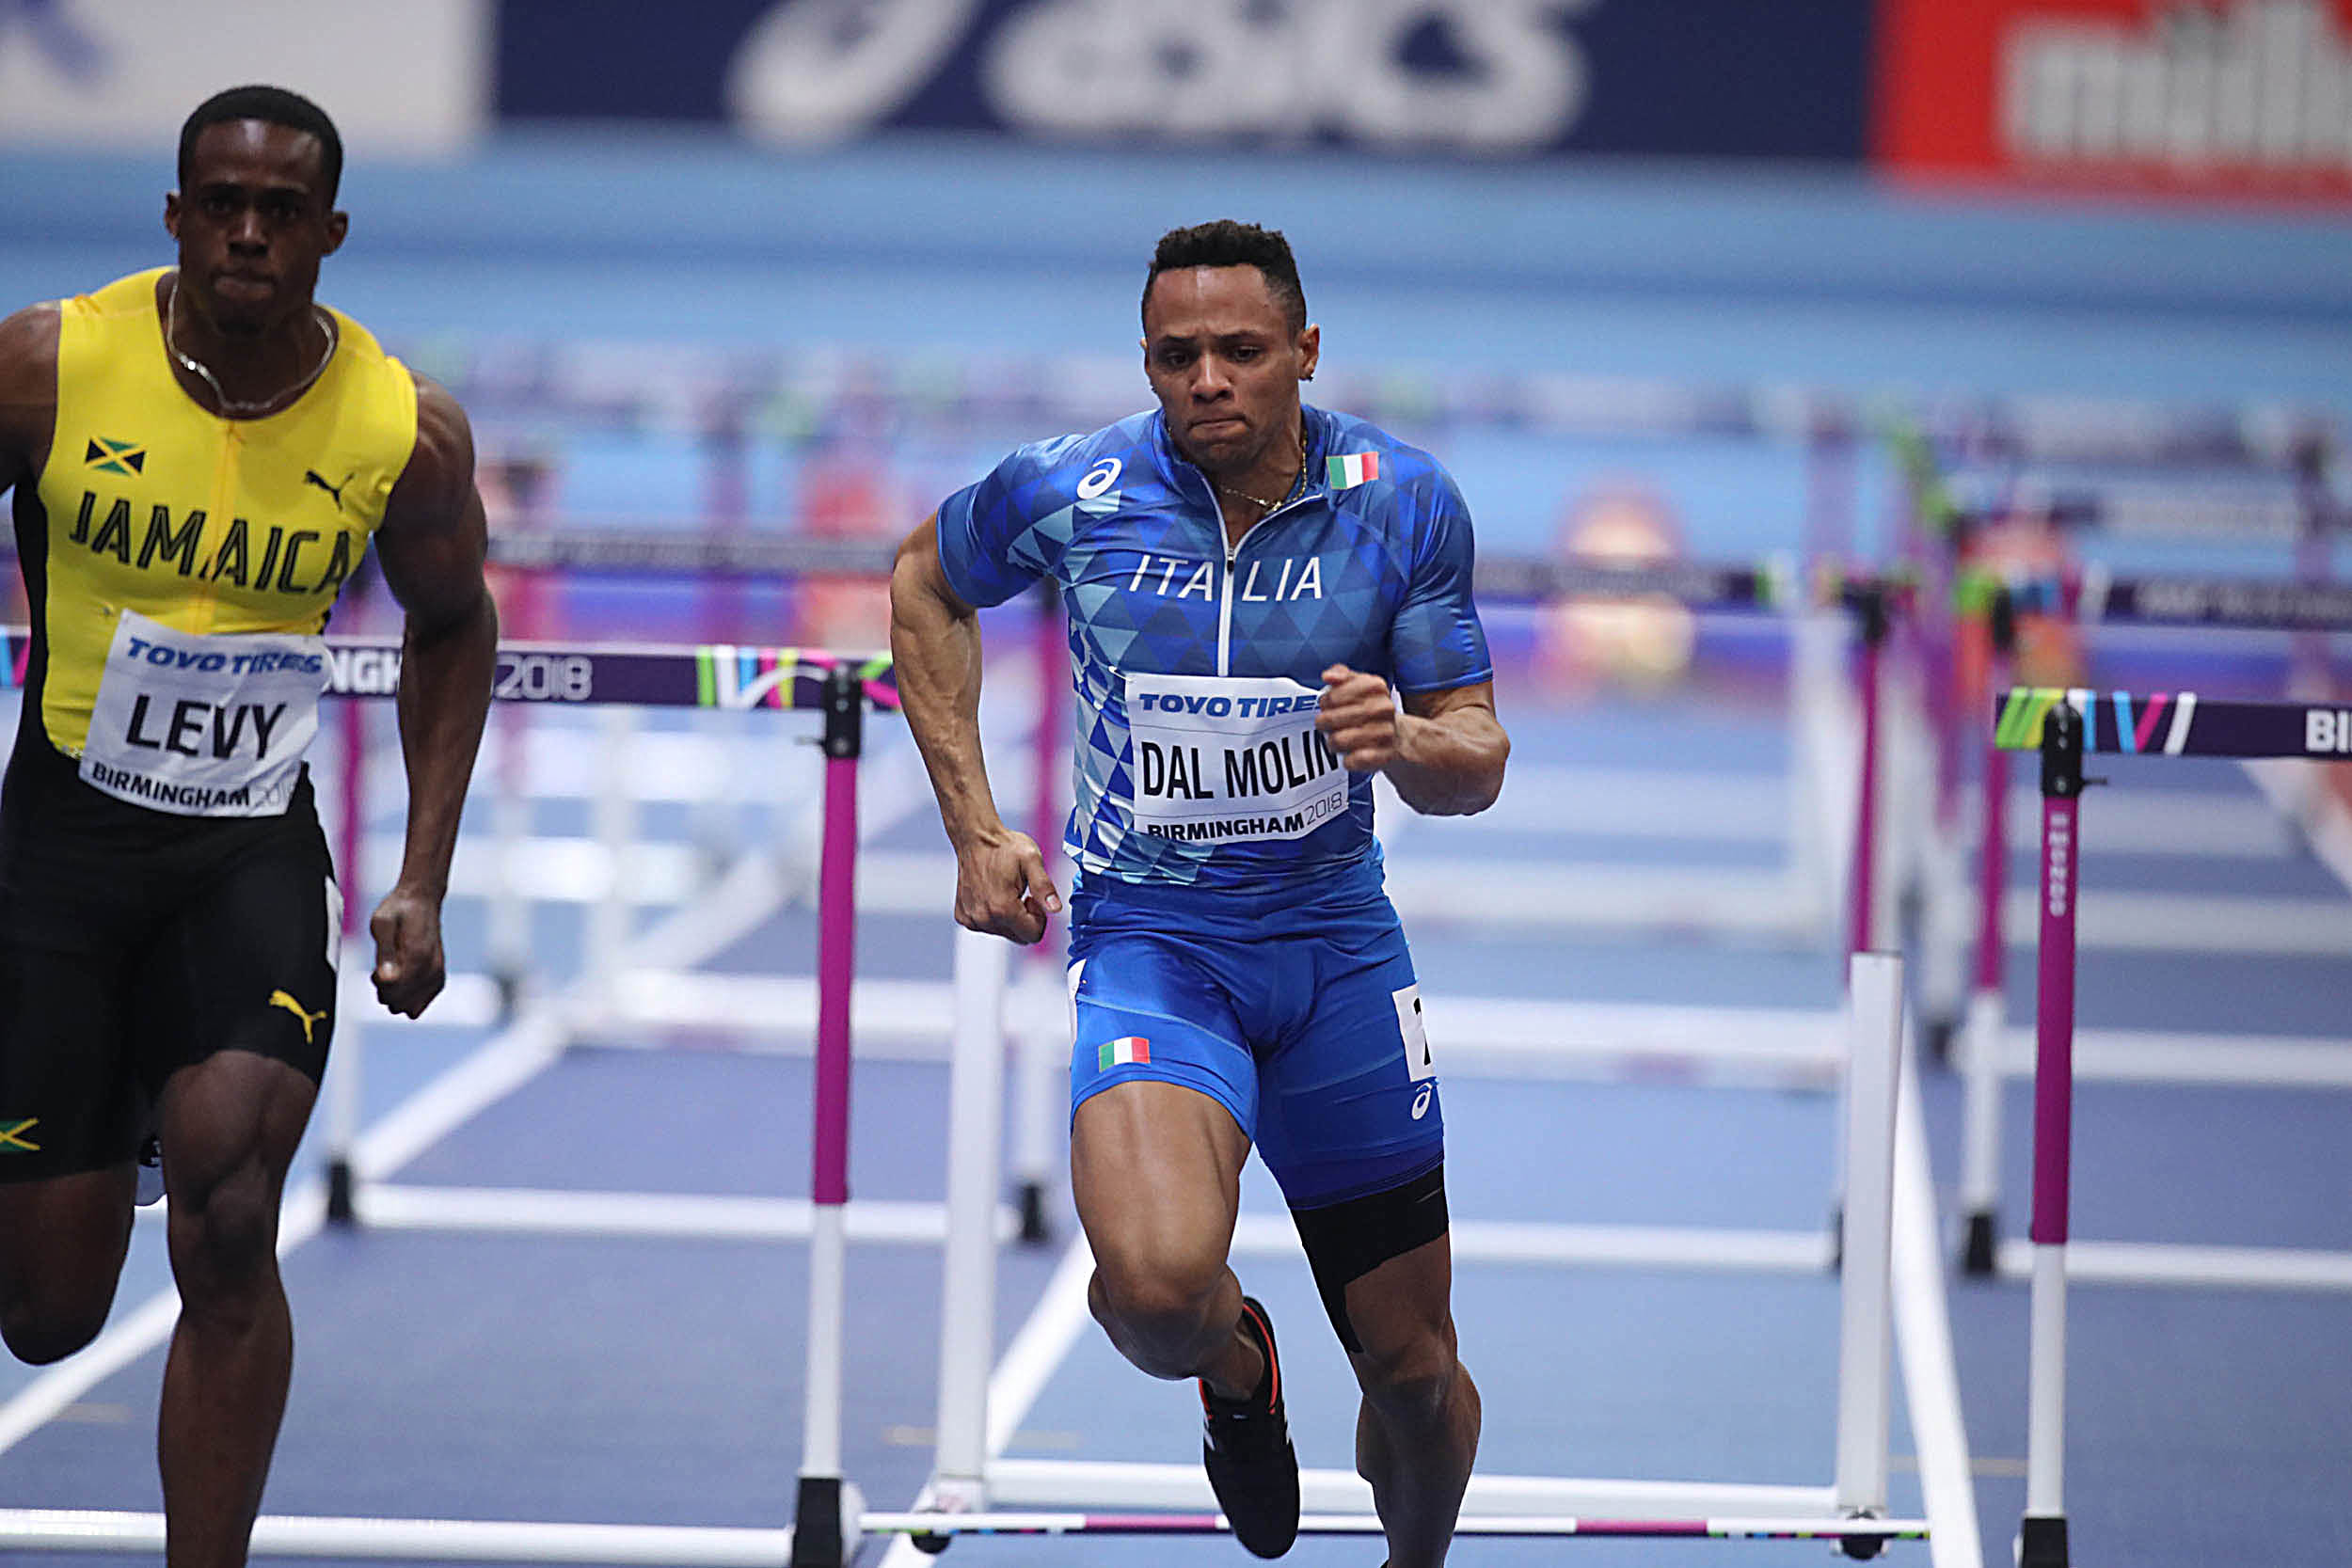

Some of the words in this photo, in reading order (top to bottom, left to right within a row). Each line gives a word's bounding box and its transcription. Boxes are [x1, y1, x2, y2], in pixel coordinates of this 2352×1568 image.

[70, 491, 349, 594] JAMAICA
[1129, 555, 1322, 601] ITALIA
[127, 637, 227, 672] TOYO
[232, 651, 323, 674] TIRES
[126, 694, 286, 761] LEVY
[1139, 693, 1232, 718] TOYO
[1237, 694, 1321, 718] TIRE
[92, 762, 250, 808] BIRMINGHAM
[1141, 741, 1214, 800] DAL
[1224, 730, 1339, 799] MOLIN
[1148, 813, 1304, 841] BIRMINGHAM
[1304, 792, 1343, 825] 2018
